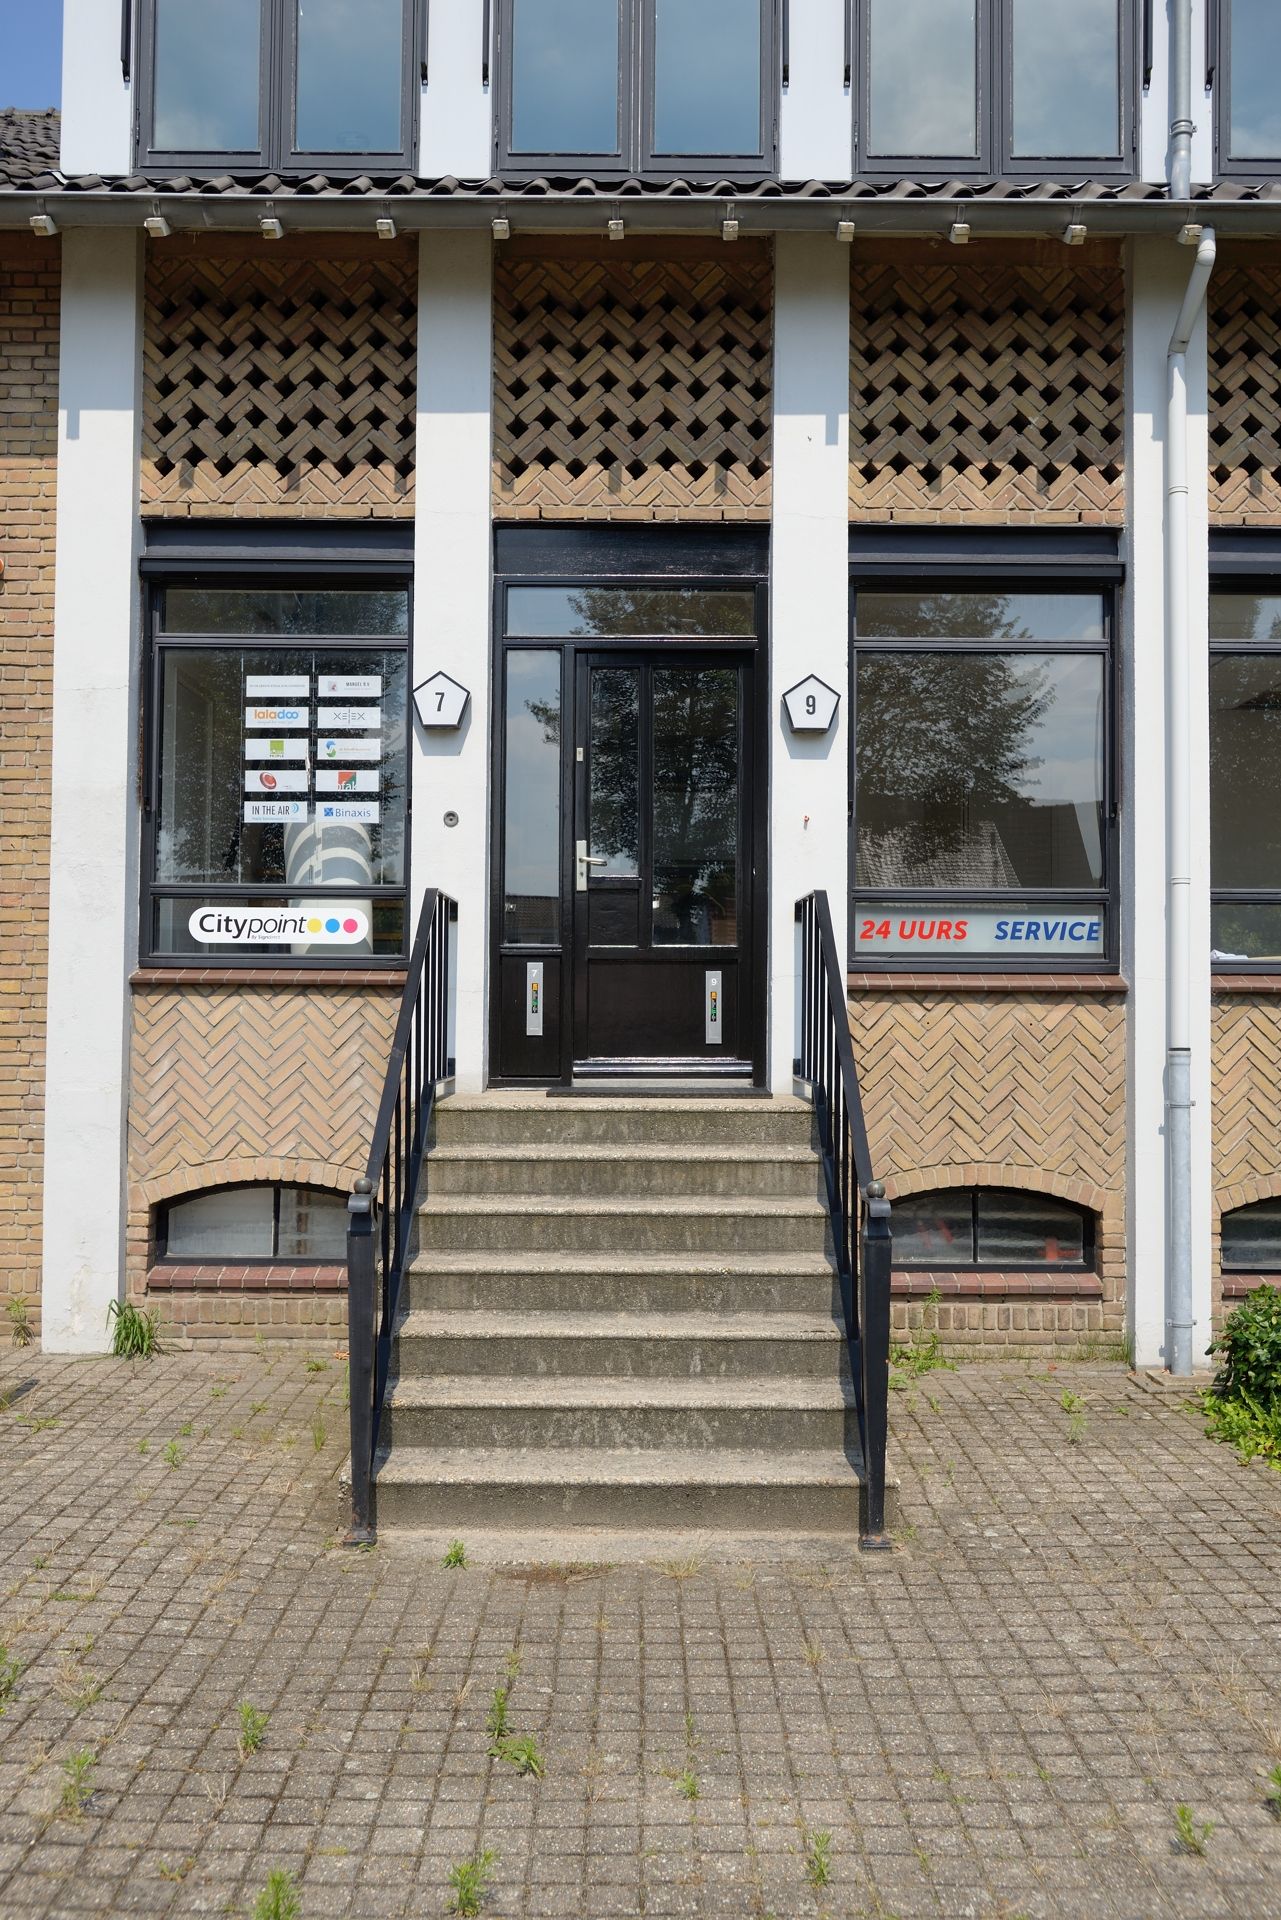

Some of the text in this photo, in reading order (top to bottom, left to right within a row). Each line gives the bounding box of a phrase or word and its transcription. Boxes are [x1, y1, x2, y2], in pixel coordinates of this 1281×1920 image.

[435, 692, 445, 712] 7
[806, 695, 816, 715] 9
[254, 709, 299, 719] laladoo
[252, 805, 290, 815] IN THE AIR
[335, 808, 371, 817] Binaxis
[199, 914, 307, 939] Citypoint
[860, 920, 1102, 941] 24 UURS SERVICE
[531, 969, 538, 977] 7
[711, 978, 717, 986] 9
